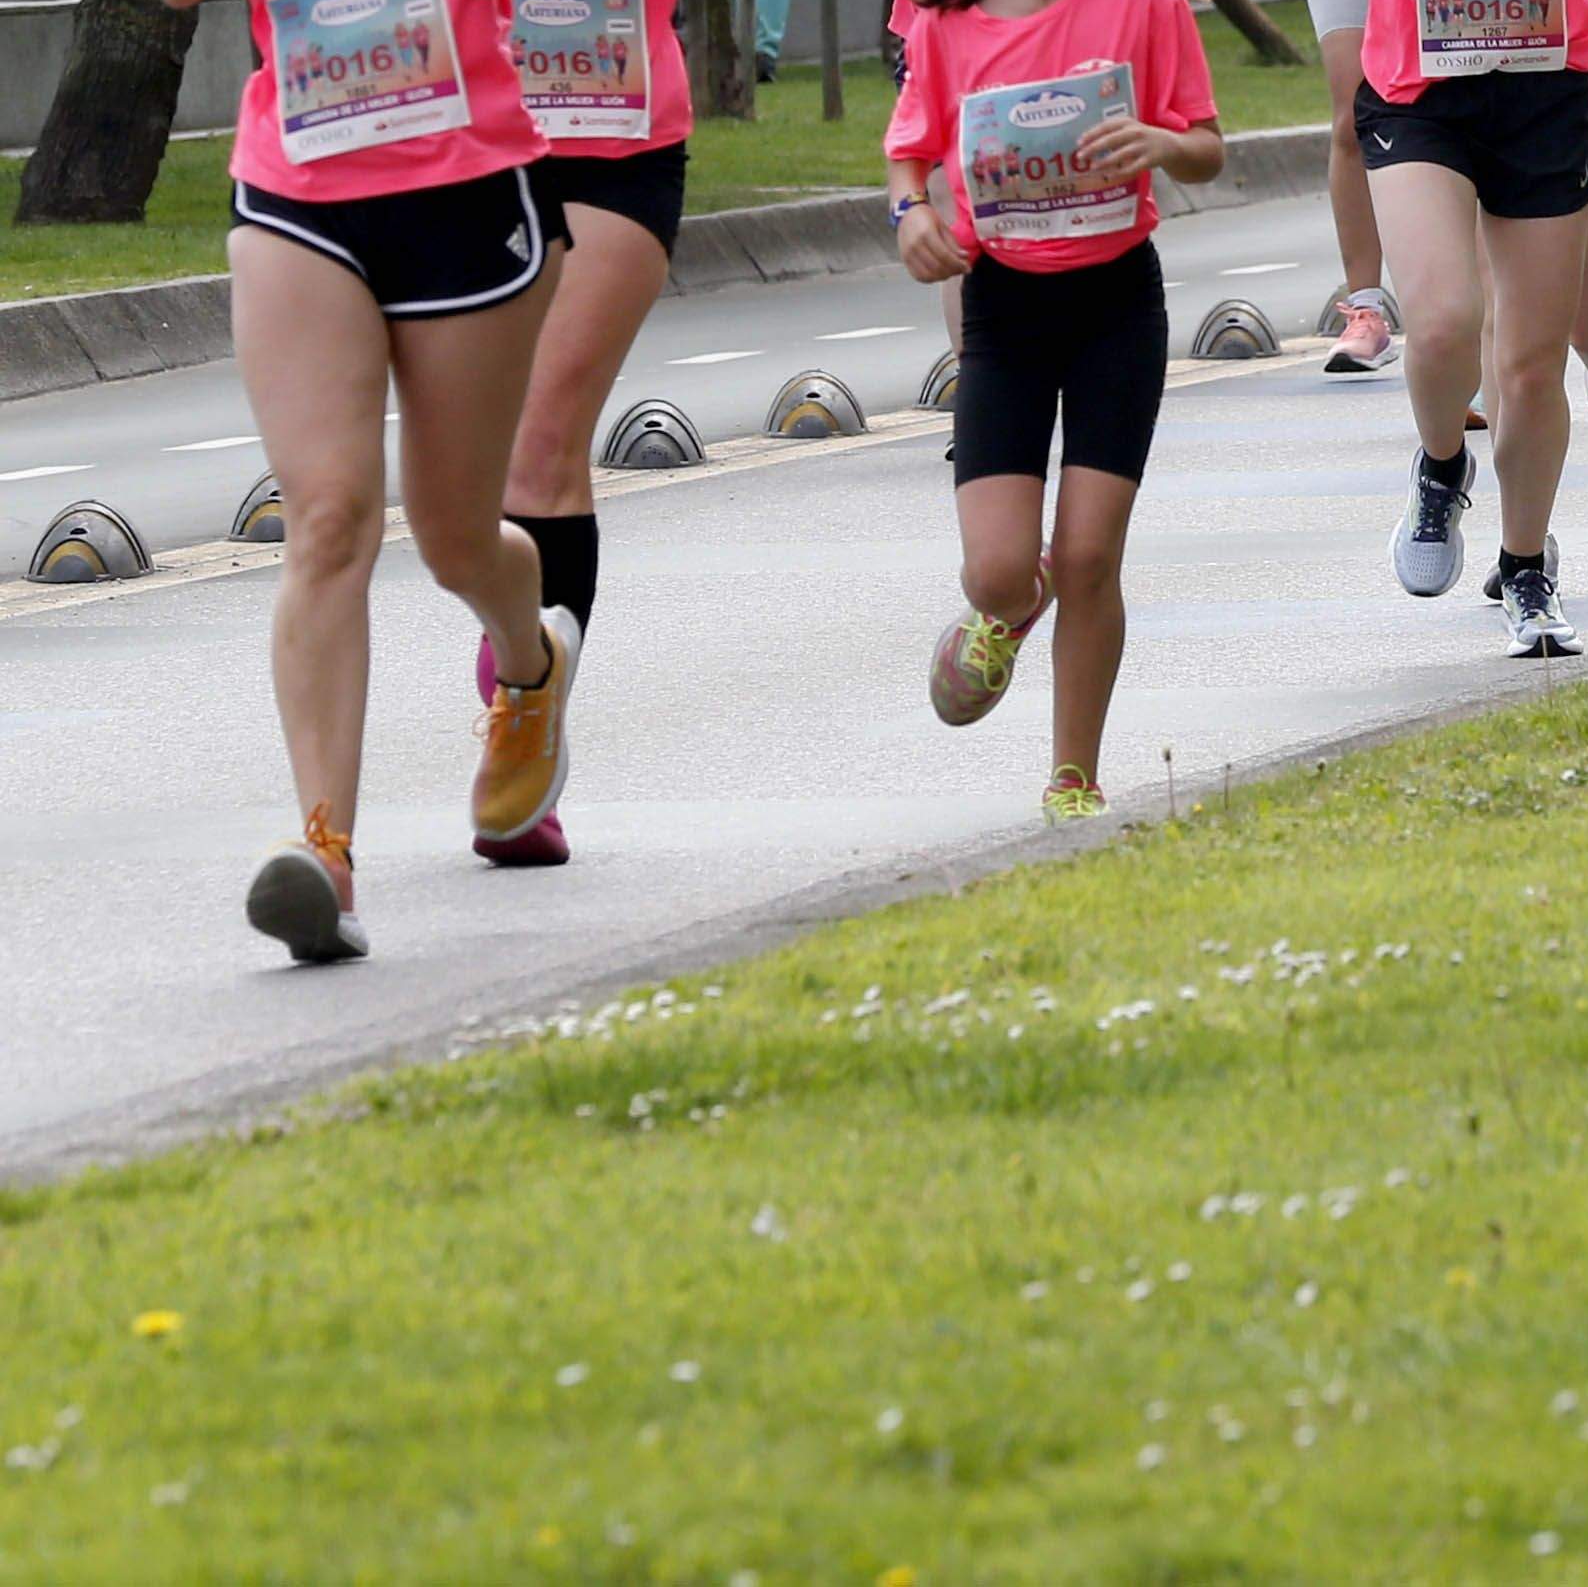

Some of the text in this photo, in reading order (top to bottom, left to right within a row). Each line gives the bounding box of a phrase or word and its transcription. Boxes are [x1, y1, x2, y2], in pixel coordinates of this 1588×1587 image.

[525, 3, 587, 18] ASTURIANA
[1482, 27, 1508, 37] 1267
[1442, 38, 1475, 49] CARRERA
[1476, 37, 1486, 47] DE
[1487, 37, 1497, 47] LA
[1499, 36, 1523, 47] MUJER
[326, 44, 394, 82] 016
[529, 50, 593, 75] 016
[1436, 55, 1483, 68] OYSHO
[550, 81, 573, 93] 436
[538, 96, 551, 106] DE
[553, 96, 565, 106] LA
[1014, 104, 1081, 124] ASTURIANA
[1024, 150, 1091, 182] 016
[1038, 199, 1050, 210] DE
[1052, 197, 1065, 208] LA
[994, 216, 1050, 231] OYSHO
